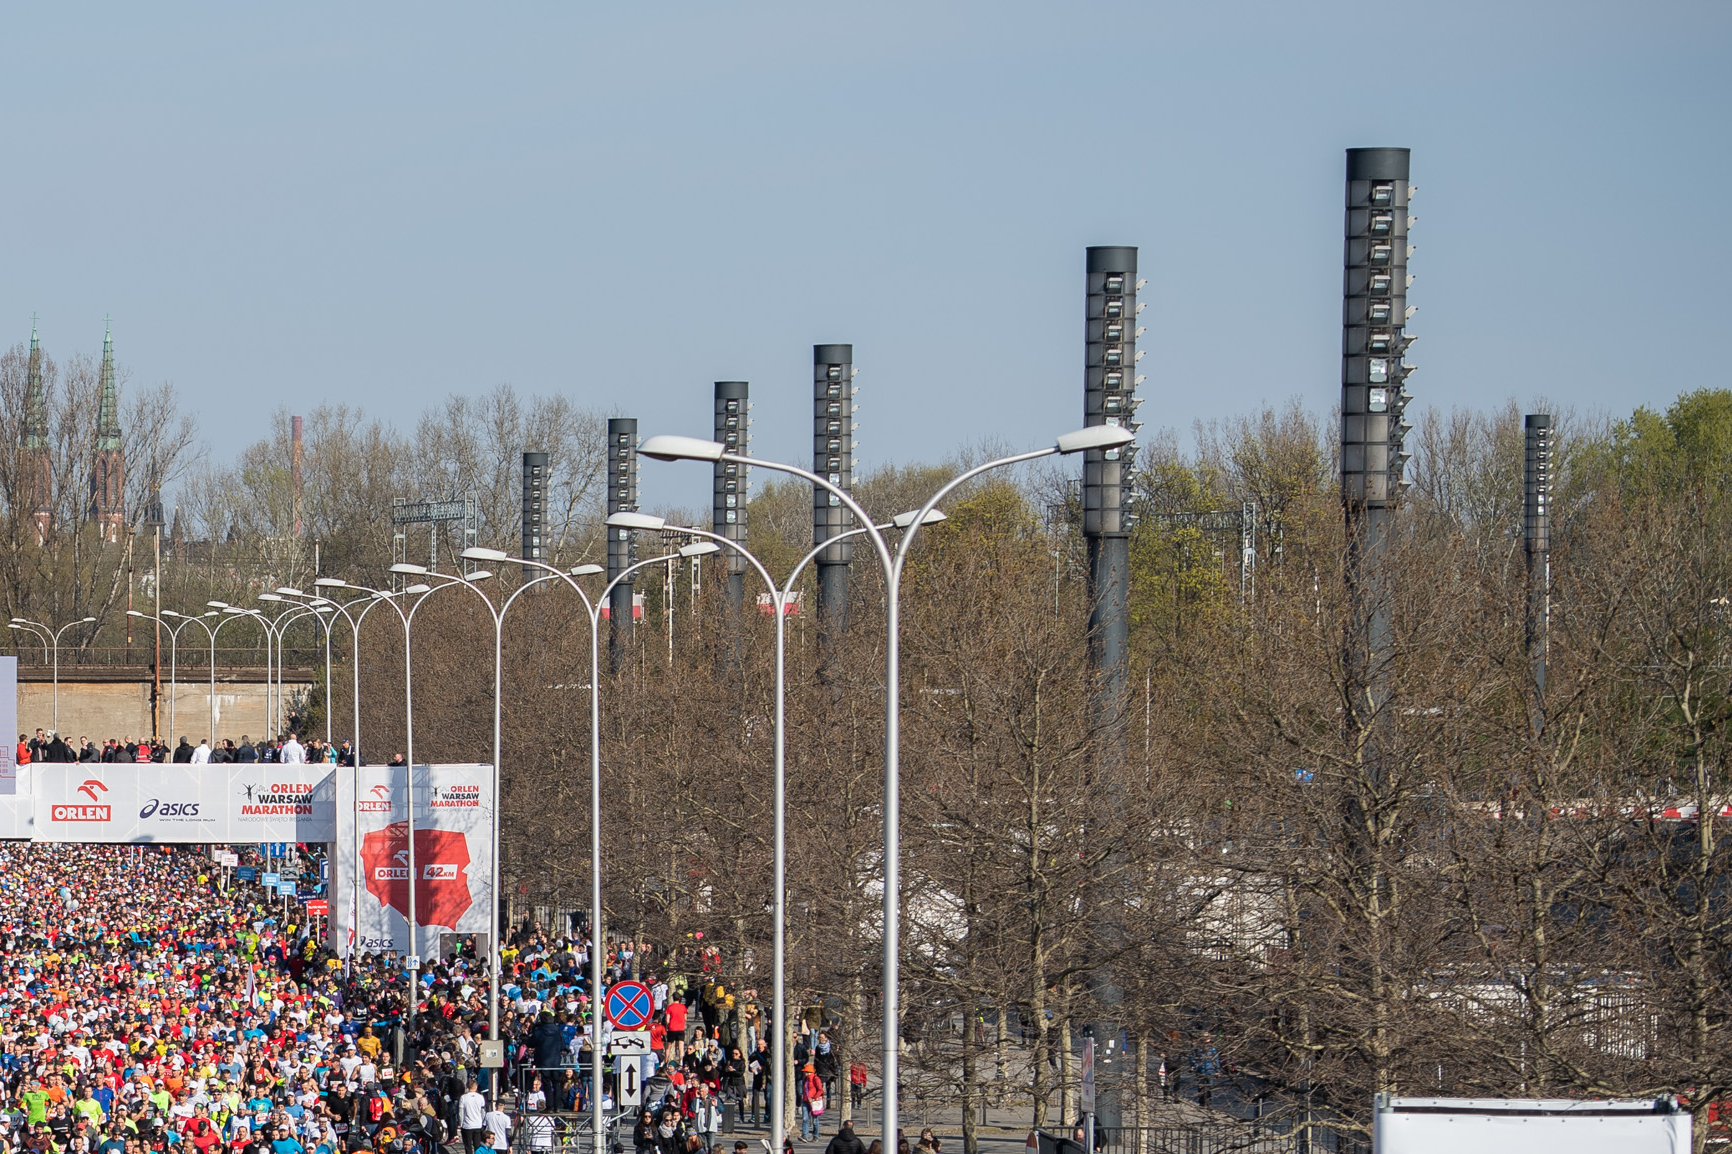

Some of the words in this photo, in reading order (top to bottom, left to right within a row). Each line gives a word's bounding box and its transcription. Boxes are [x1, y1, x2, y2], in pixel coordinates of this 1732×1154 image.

[270, 783, 312, 794] ORLEN
[257, 794, 313, 804] WARSAW
[430, 799, 479, 807] MARATHON
[54, 806, 109, 820] ORLEN
[159, 803, 199, 816] asics
[241, 804, 313, 815] MARATHON
[377, 869, 409, 878] ORLE
[426, 866, 455, 878] 42KM
[367, 938, 393, 948] asics
